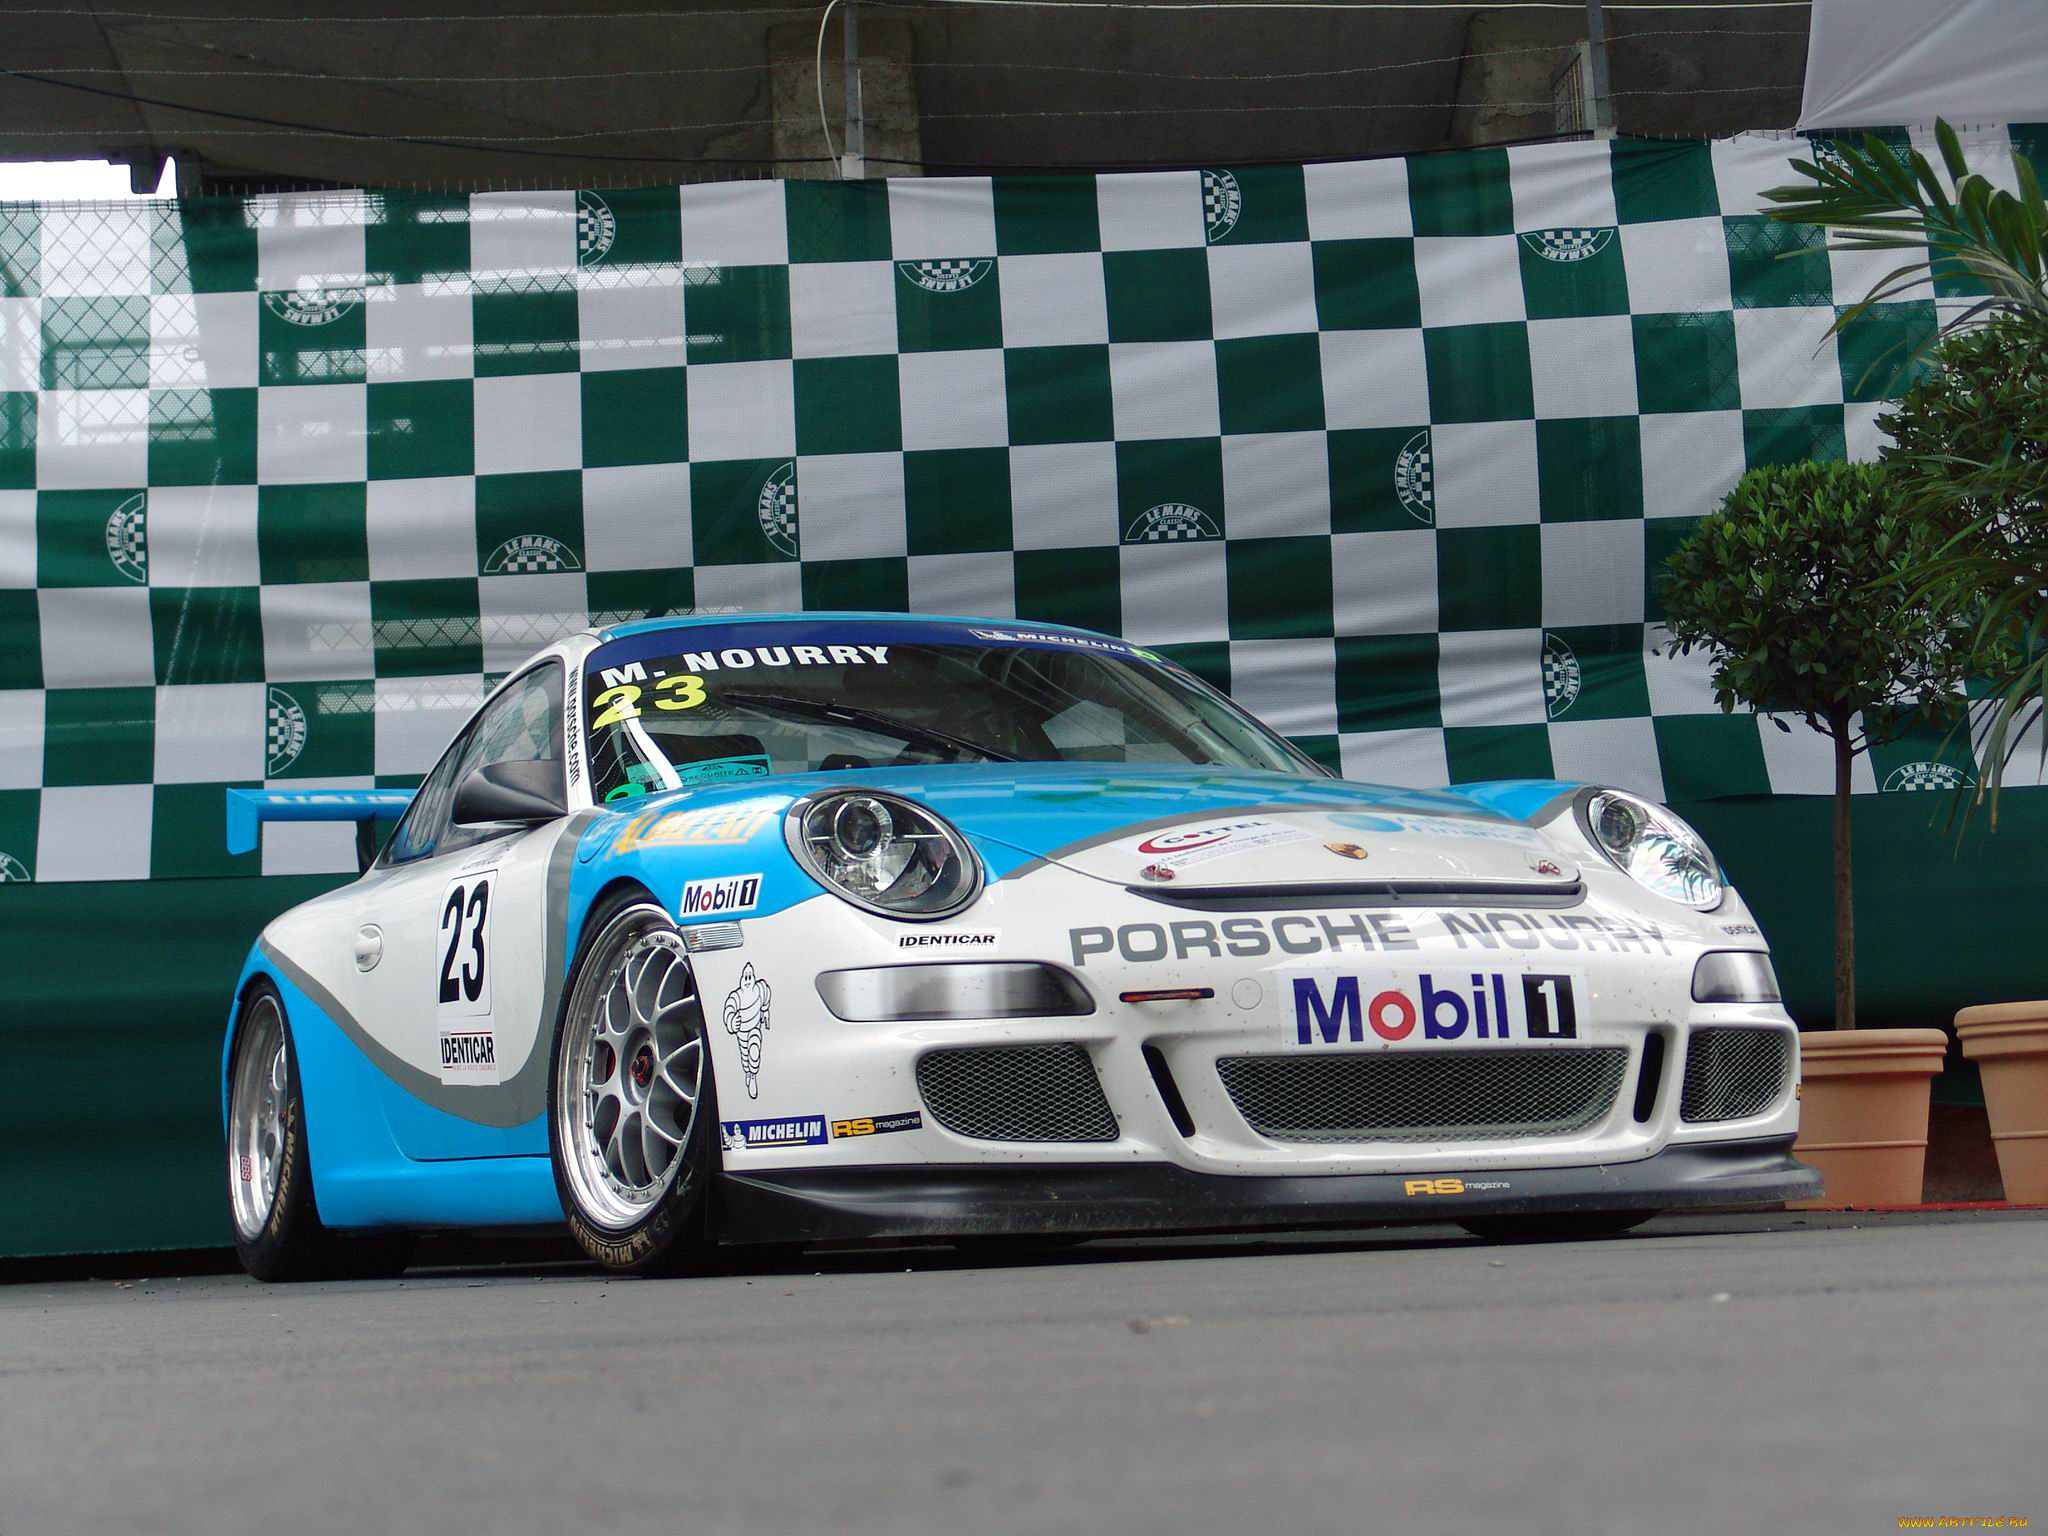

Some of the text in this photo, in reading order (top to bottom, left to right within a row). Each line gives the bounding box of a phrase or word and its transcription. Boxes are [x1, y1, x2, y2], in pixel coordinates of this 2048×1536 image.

[1224, 189, 1239, 226] MANS
[1541, 247, 1580, 259] MANS
[919, 277, 957, 290] MANS
[1397, 450, 1413, 488] MANS
[760, 481, 777, 520] MANS
[1146, 505, 1201, 523] LE MANS
[504, 536, 560, 554] LE MANS
[1017, 633, 1126, 652] MICHELIN
[600, 646, 888, 688] M. NOURRY
[1564, 666, 1579, 700] MANS
[592, 675, 706, 730] 23
[1900, 765, 1915, 777] LE
[683, 880, 756, 913] Mobil 1
[439, 879, 488, 1003] 23
[899, 935, 995, 947] IDENTICAR
[1069, 913, 1419, 966] PORSCHE
[1292, 974, 1568, 1045] Mobil 1
[440, 1036, 495, 1064] IDENTICAR
[749, 1121, 821, 1141] MICHELIN
[833, 1117, 921, 1137] RS magazine
[240, 1156, 251, 1181] BBS
[1404, 1178, 1511, 1196] RS magazine
[569, 1214, 634, 1265] MICHELIN
